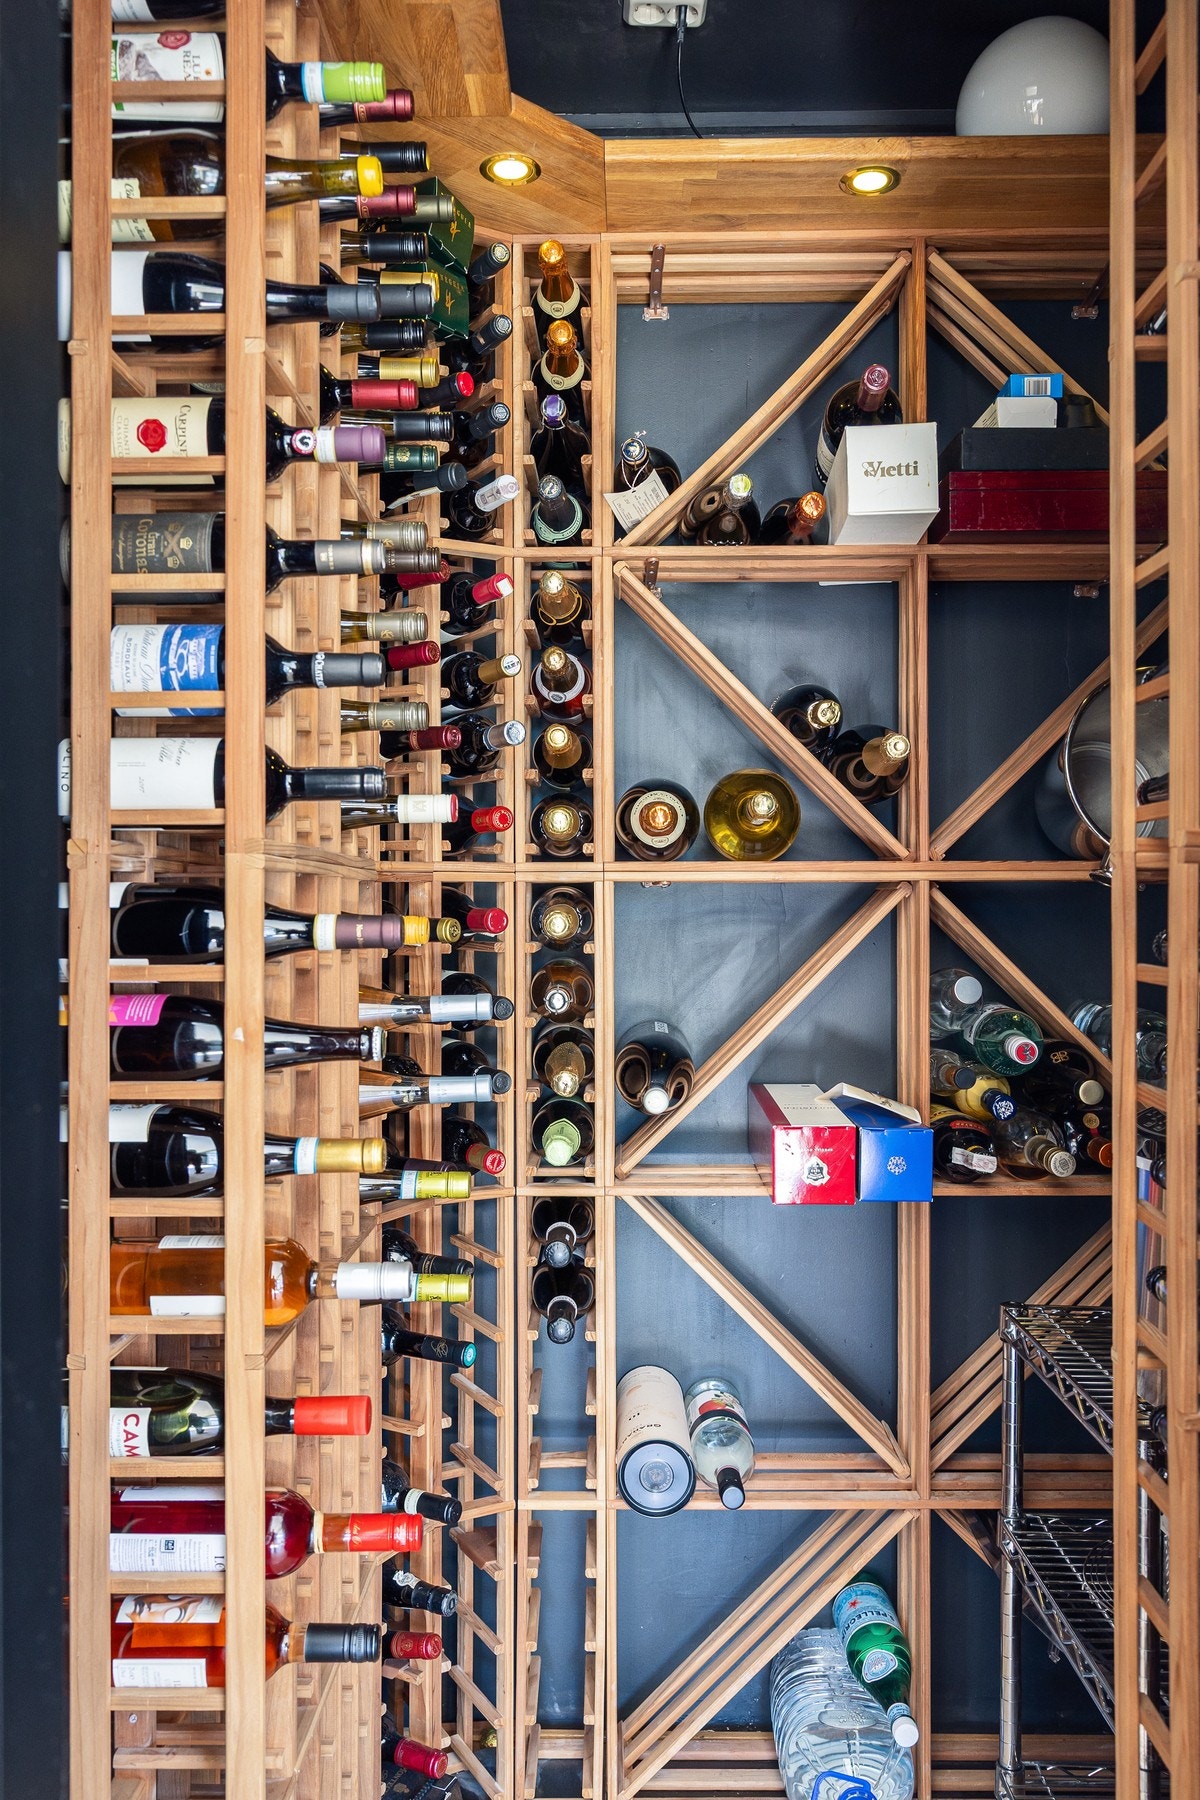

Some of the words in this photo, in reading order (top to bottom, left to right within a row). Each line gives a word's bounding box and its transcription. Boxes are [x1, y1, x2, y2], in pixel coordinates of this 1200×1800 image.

[862, 460, 920, 478] Vietti
[135, 519, 154, 573] Coronas
[147, 531, 157, 556] Gran
[124, 637, 132, 685] BORDEAUX
